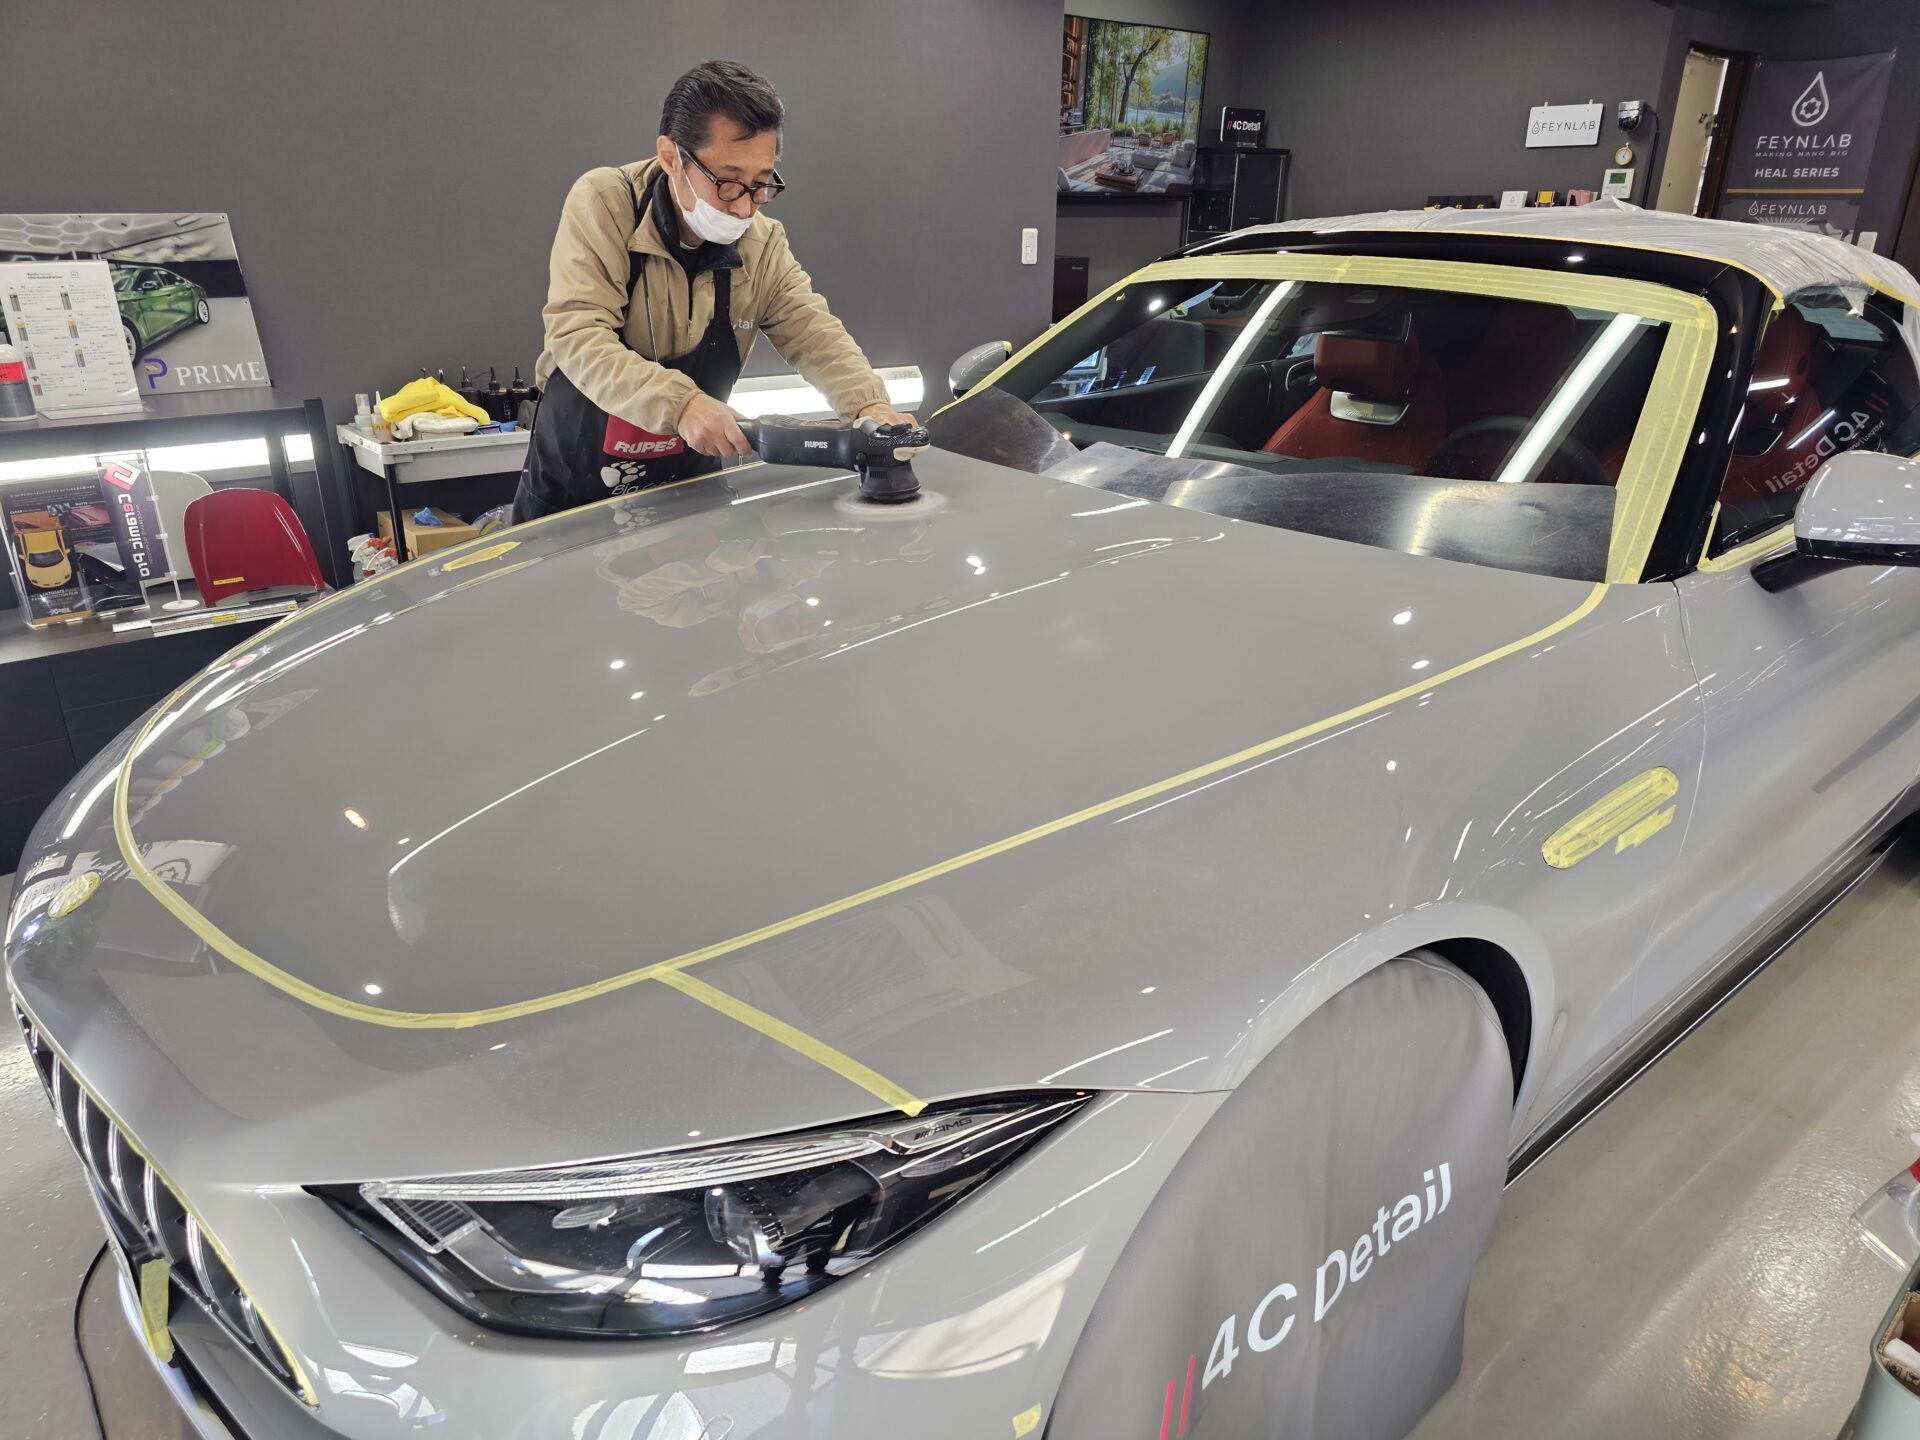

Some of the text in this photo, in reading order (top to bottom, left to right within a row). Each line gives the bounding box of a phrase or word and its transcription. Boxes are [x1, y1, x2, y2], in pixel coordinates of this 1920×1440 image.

[1232, 121, 1242, 131] 4C
[1541, 120, 1596, 132] FEYNLAB
[1756, 133, 1852, 150] FEYNLAB
[1754, 167, 1840, 178] HEAL SERIES
[1759, 204, 1827, 215] FEYNLAB
[174, 361, 265, 387] PRIME
[613, 438, 677, 454] RUPES
[804, 440, 828, 449] RUPES
[931, 1117, 973, 1134] AMG
[1313, 1162, 1453, 1323] Detail
